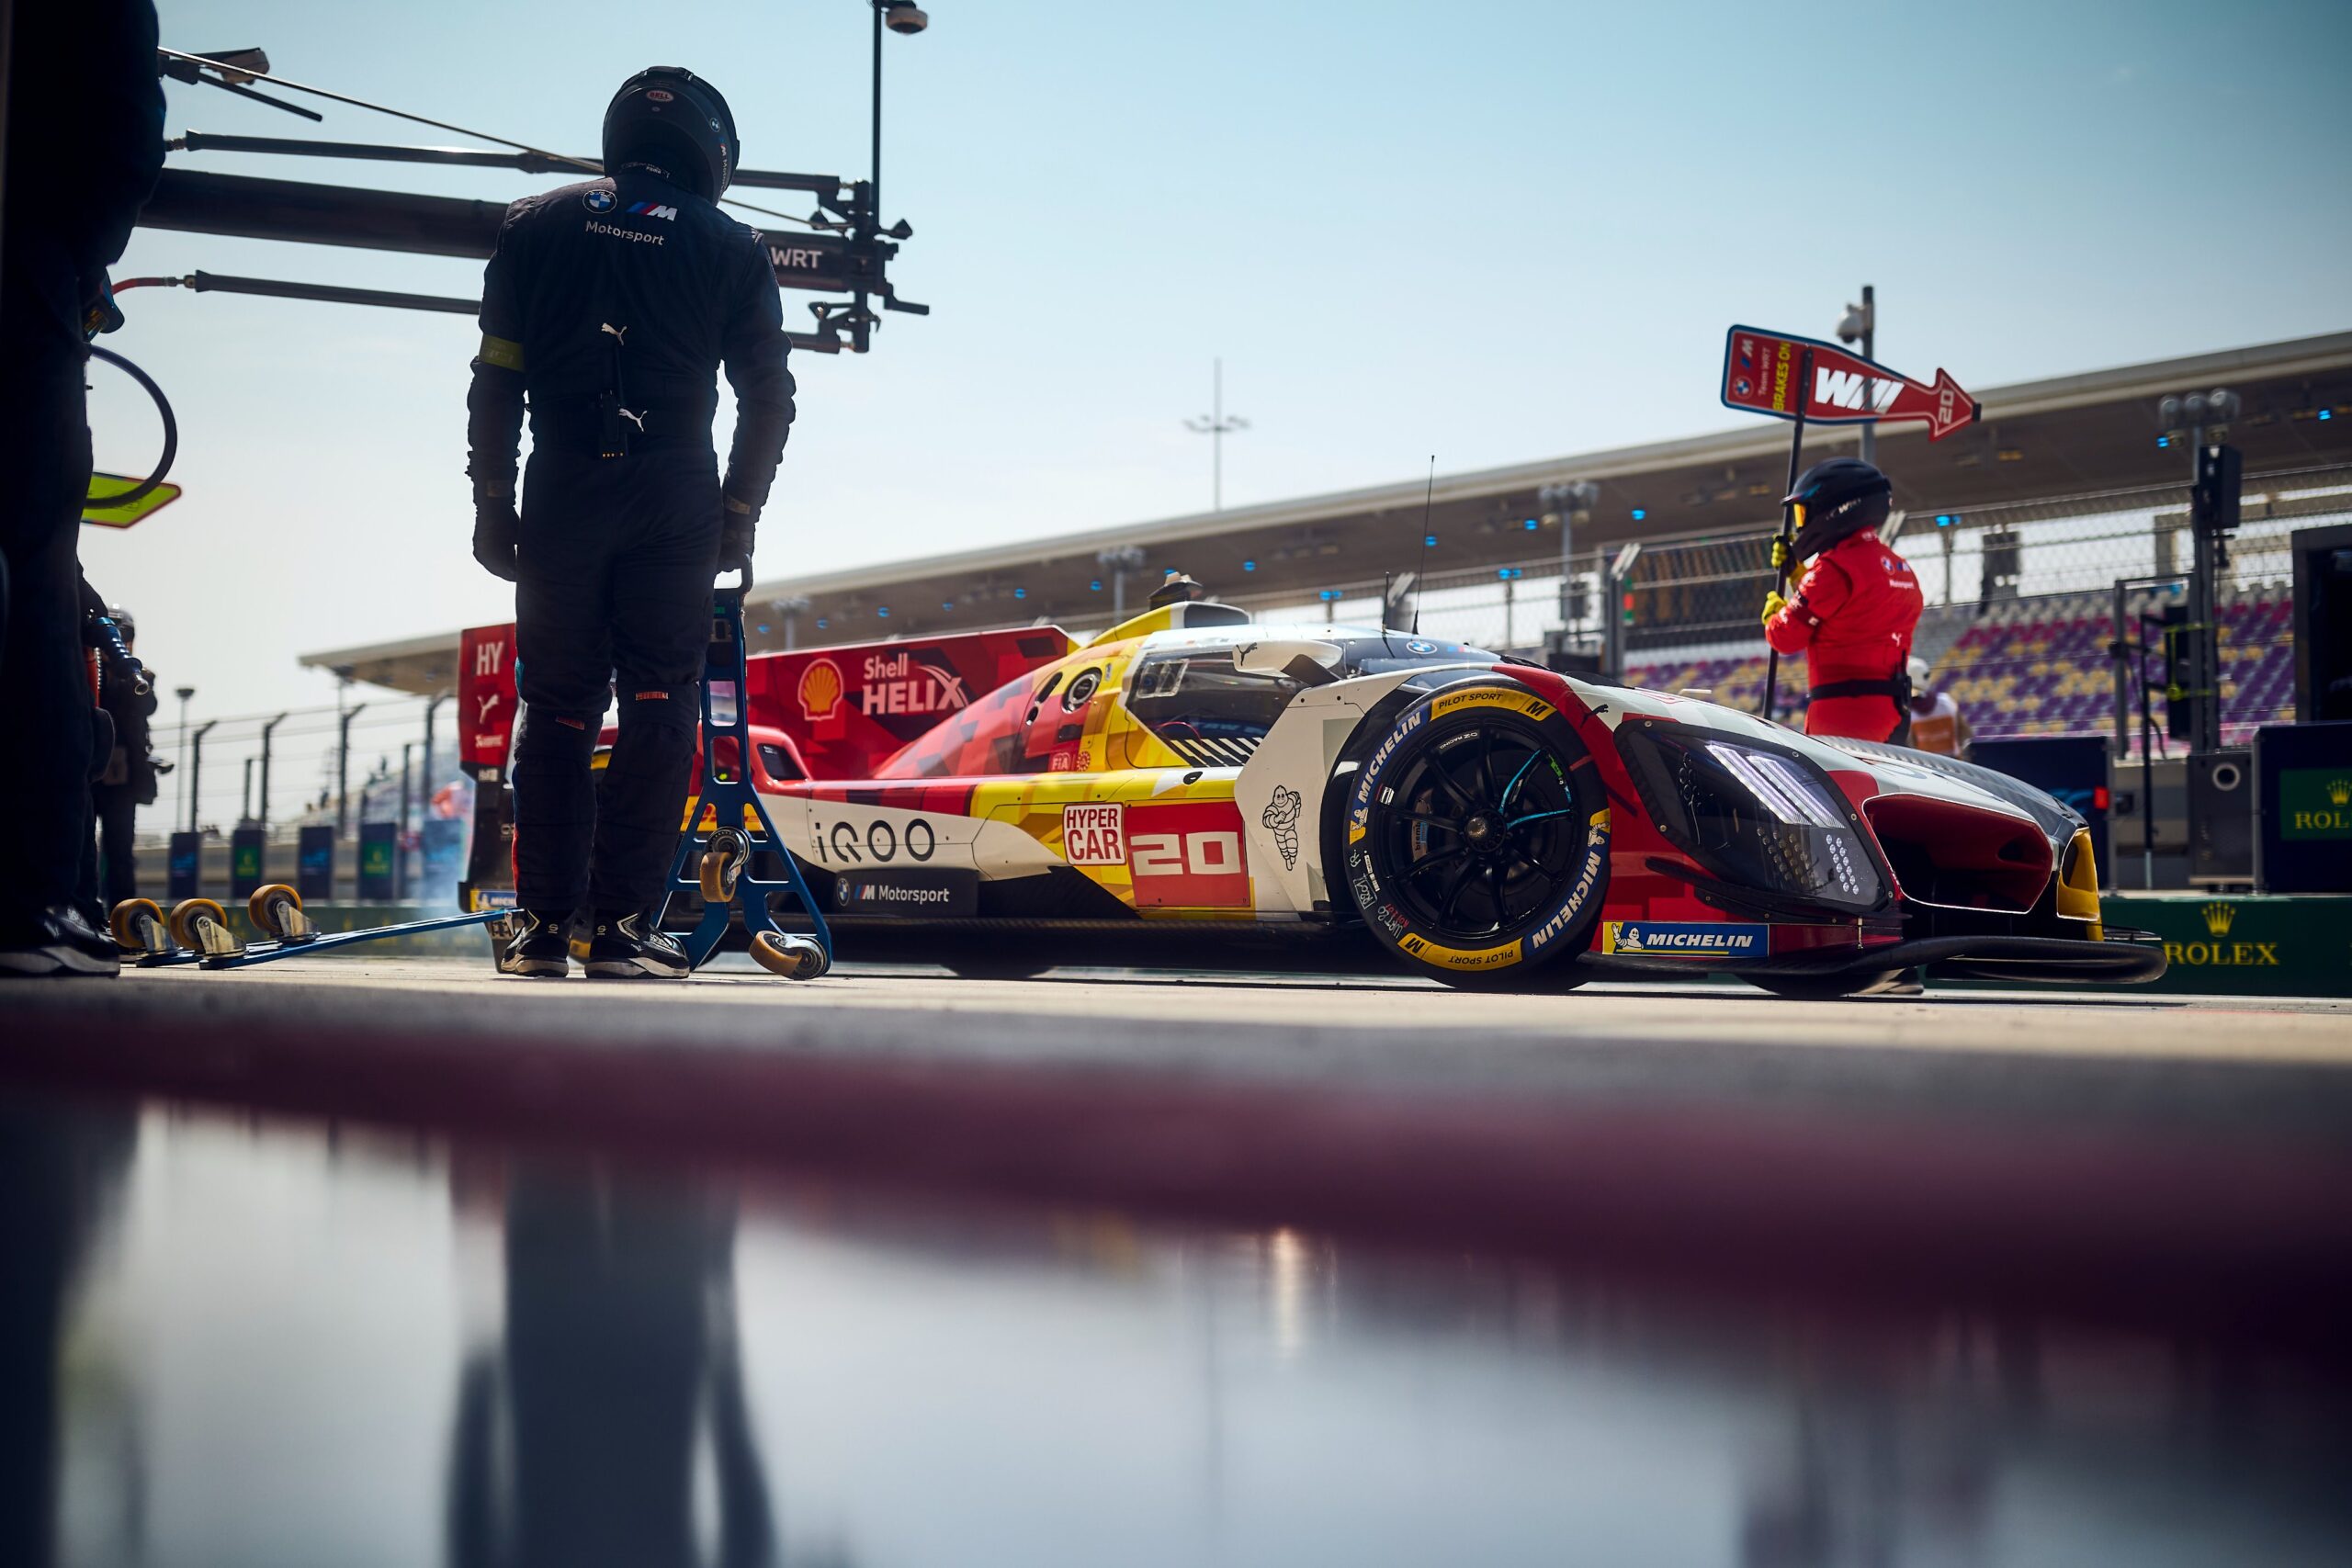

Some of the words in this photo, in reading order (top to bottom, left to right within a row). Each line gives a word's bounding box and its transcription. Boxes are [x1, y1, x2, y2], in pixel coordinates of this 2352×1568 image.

[586, 220, 664, 246] Motorsport
[770, 246, 823, 269] WRT
[1779, 341, 1791, 361] ON
[1772, 361, 1790, 412] BRAKES
[1939, 389, 1955, 424] 20
[476, 641, 503, 676] HY
[864, 652, 909, 680] Shell
[862, 675, 968, 716] HELIX
[1439, 694, 1467, 710] PILOT
[1468, 693, 1504, 701] SPORT
[1525, 701, 1549, 716] M
[1358, 712, 1421, 804] MICHELIN
[1066, 807, 1118, 829] HYPER
[2294, 809, 2352, 829] ROL
[815, 818, 935, 863] iQOO
[1068, 829, 1122, 861] CAR
[1414, 821, 1422, 852] bremb
[1130, 831, 1241, 876] 20
[878, 885, 950, 905] Motorsport
[1532, 851, 1601, 949] MICHELIN
[1404, 937, 1426, 954] M
[1646, 933, 1753, 948] MICHELIN
[2163, 941, 2279, 965] ROLEX
[1448, 955, 1482, 964] SPORT
[1485, 950, 1514, 964] PILOT
